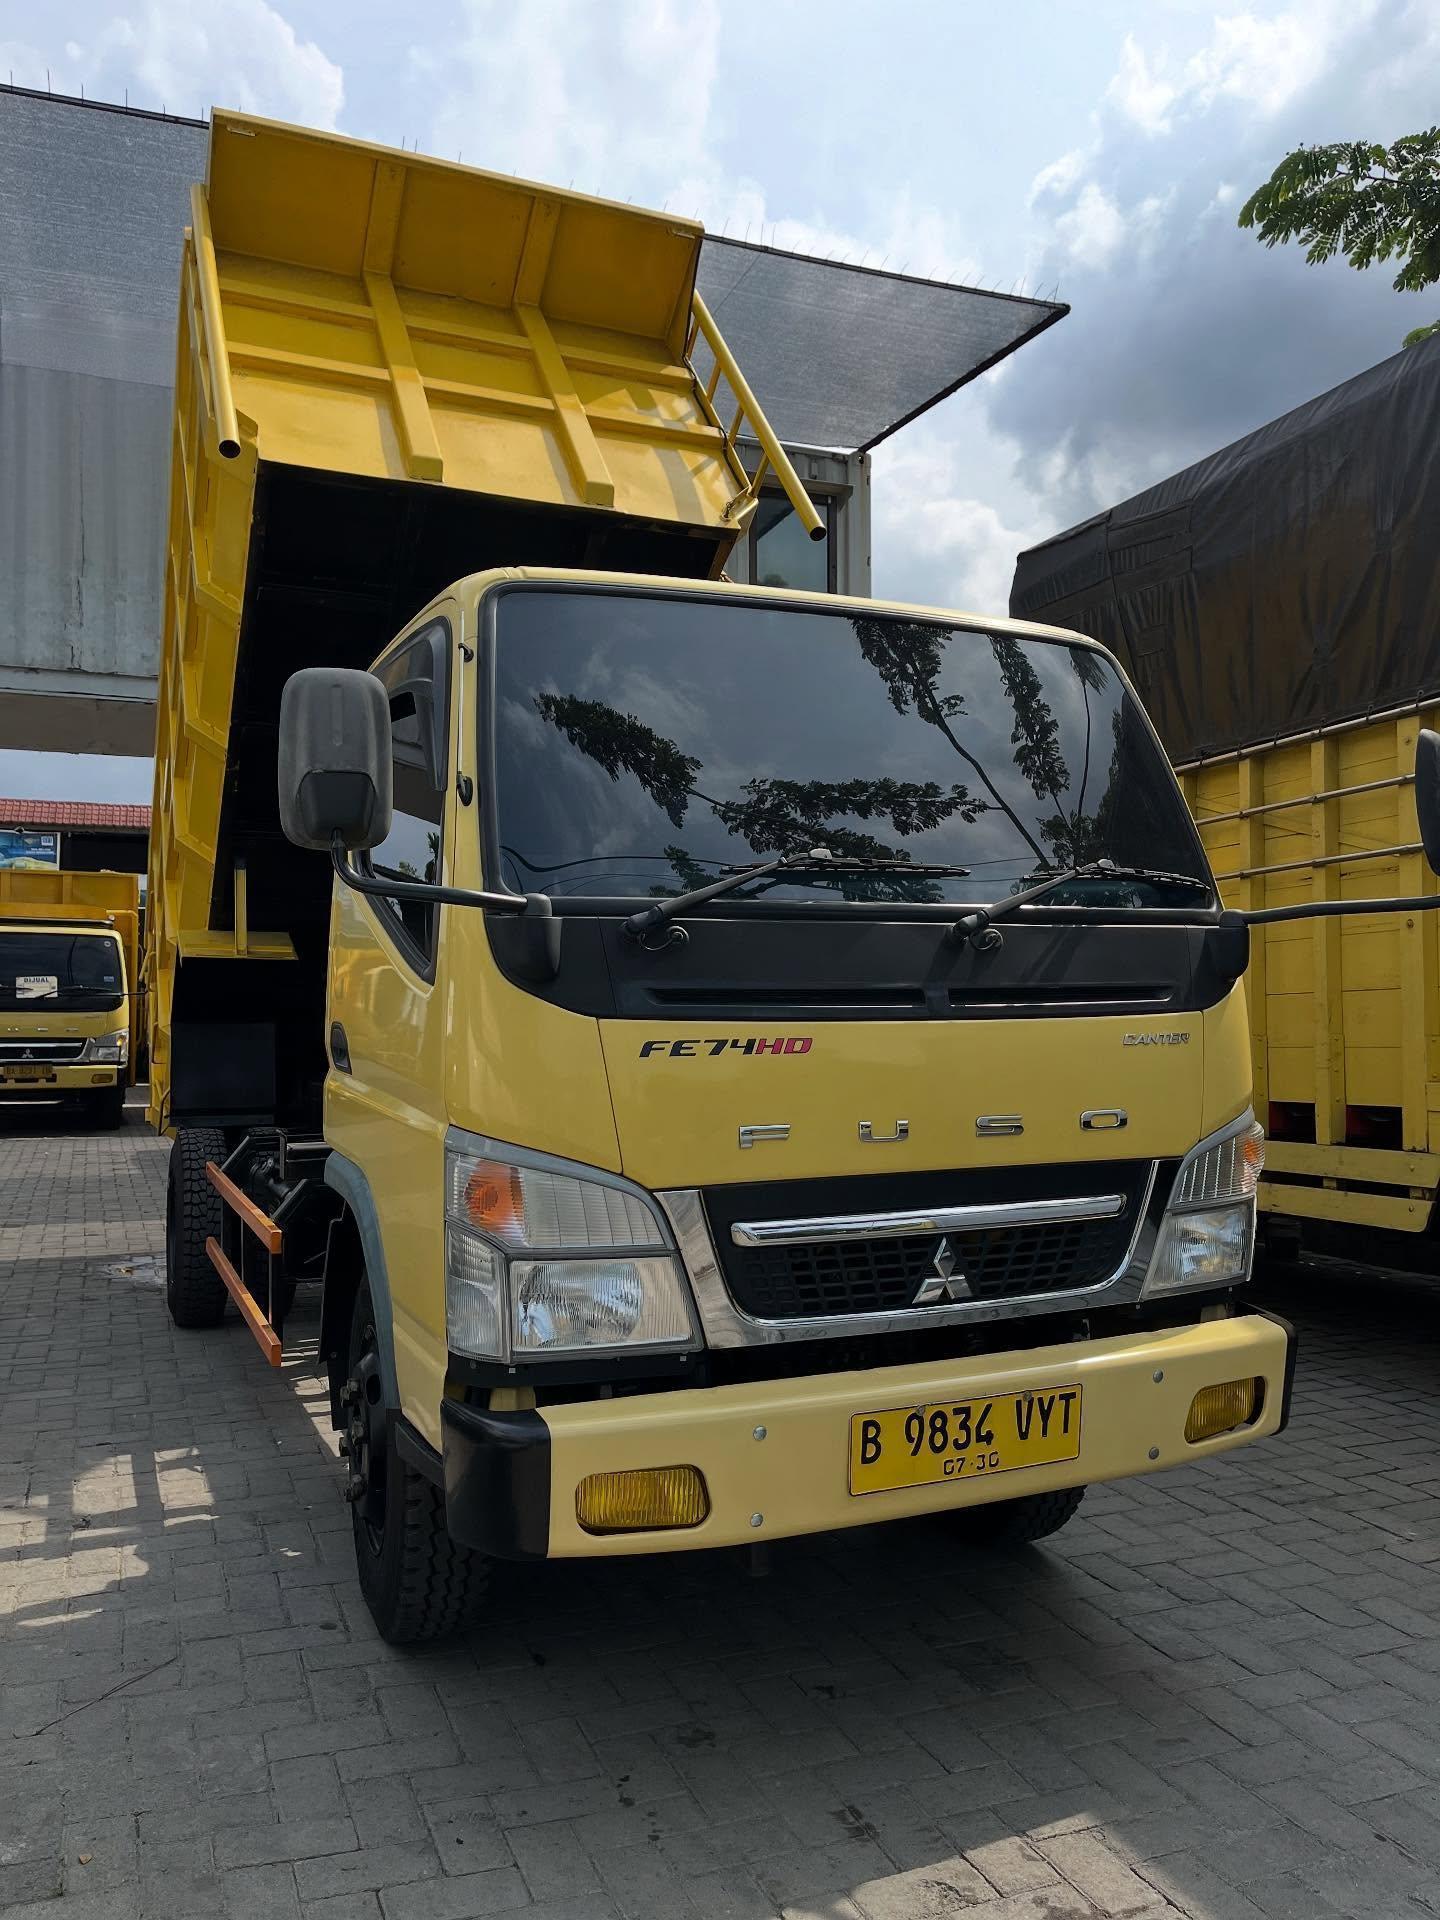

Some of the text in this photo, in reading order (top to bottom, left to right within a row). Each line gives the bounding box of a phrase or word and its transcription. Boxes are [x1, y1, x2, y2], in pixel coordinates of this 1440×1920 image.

[639, 1037, 813, 1058] FE74HD
[1122, 1032, 1190, 1046] CANTER
[738, 1108, 1128, 1149] FUSO
[860, 1419, 882, 1465] B
[904, 1403, 994, 1457] 9834
